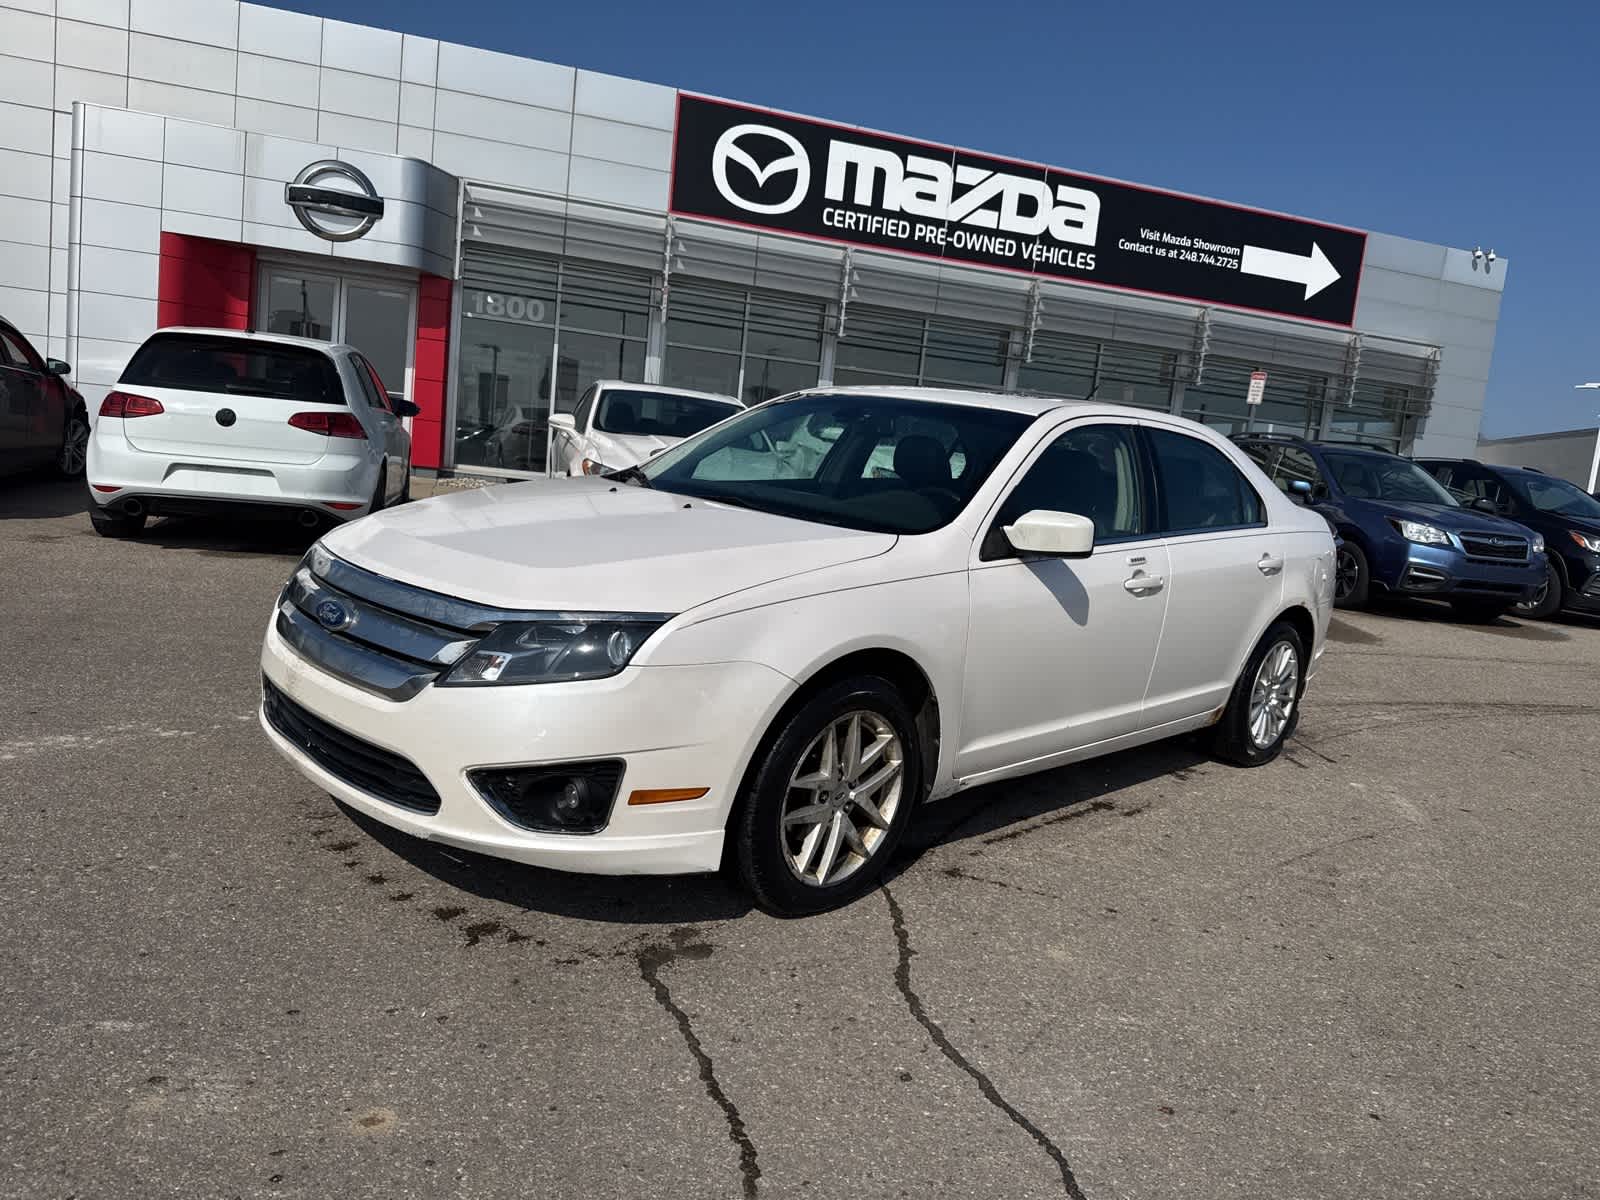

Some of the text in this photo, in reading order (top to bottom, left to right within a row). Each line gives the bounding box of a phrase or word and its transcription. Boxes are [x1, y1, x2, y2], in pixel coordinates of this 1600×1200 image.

[822, 207, 1096, 271] CERTIFIED PRE-OWNED VEHICLES
[1118, 238, 1239, 270] Contact us at 248.744.2725
[1140, 228, 1240, 256] Visit Mazda Showroom
[472, 291, 545, 321] 1800
